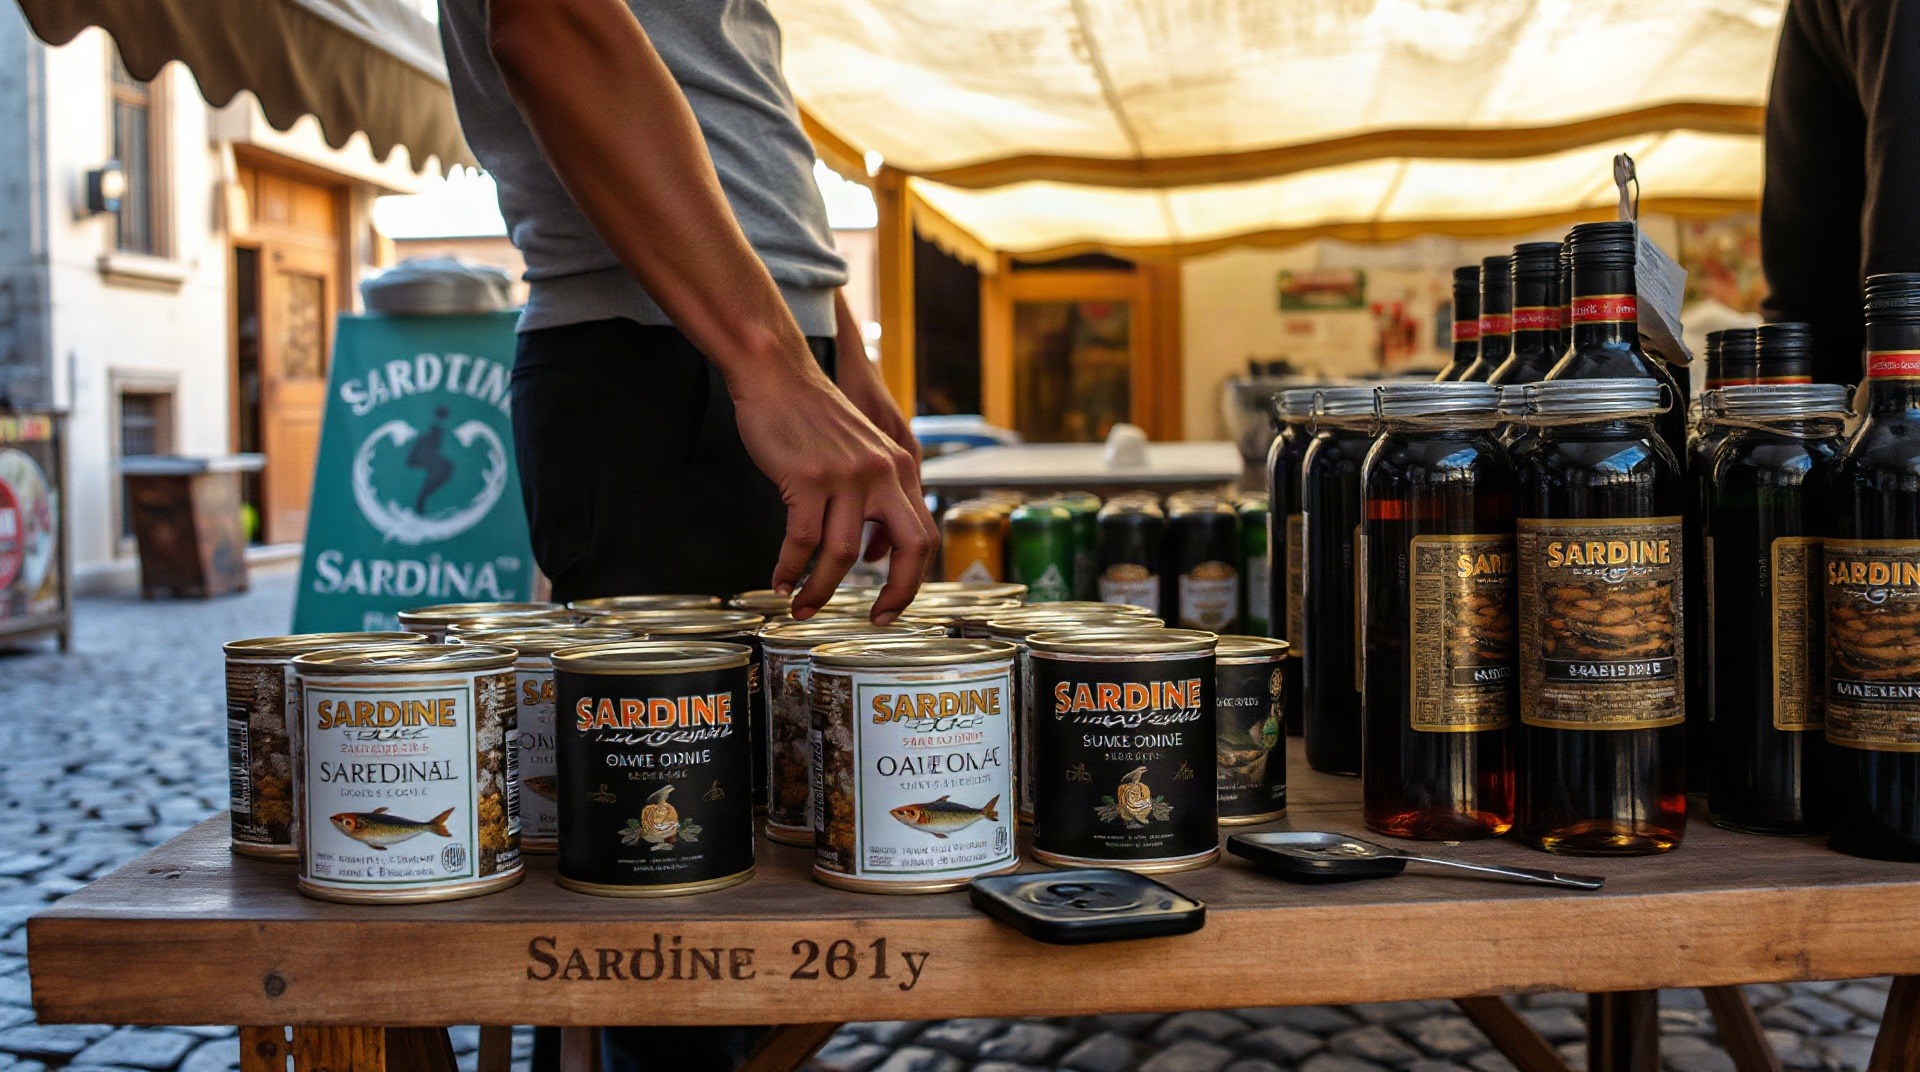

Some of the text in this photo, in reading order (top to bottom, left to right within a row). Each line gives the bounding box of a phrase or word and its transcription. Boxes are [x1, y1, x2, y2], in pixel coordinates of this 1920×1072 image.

[1547, 539, 1671, 568] SARDINE
[317, 697, 457, 731] SARDINE
[575, 691, 733, 732] SARDINE
[872, 687, 1001, 724] SARDINE
[1054, 677, 1202, 716] SARDINE
